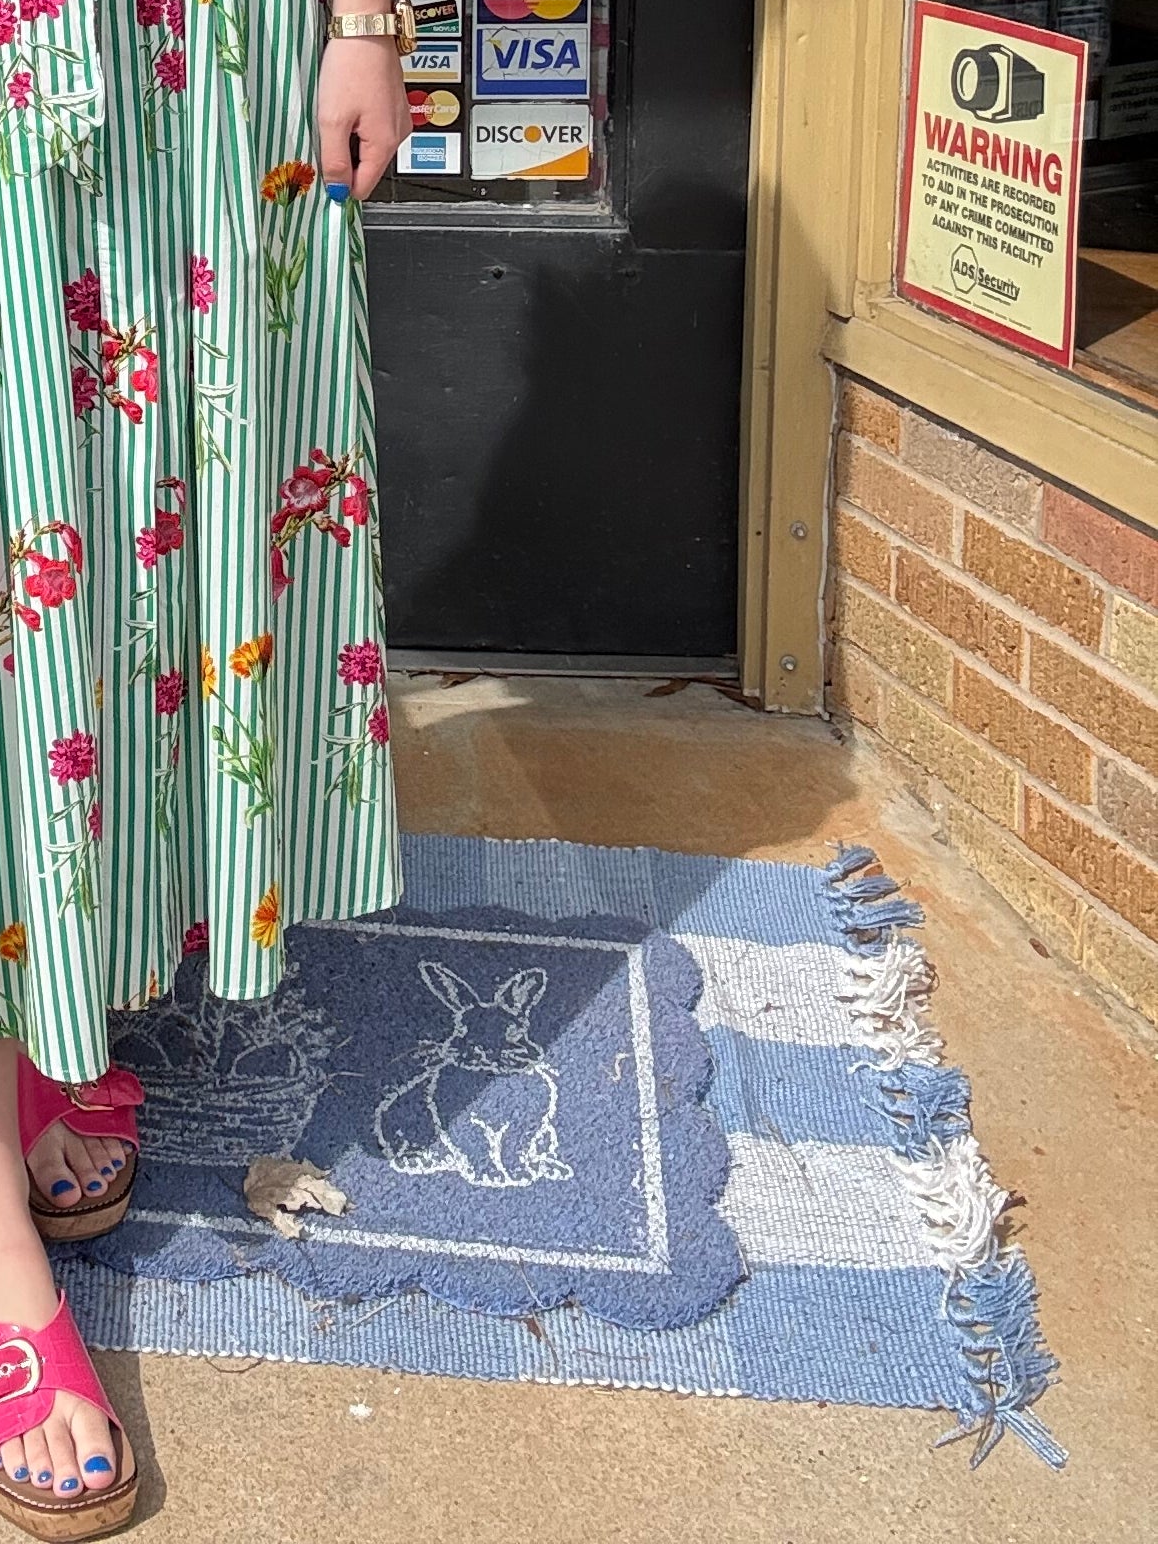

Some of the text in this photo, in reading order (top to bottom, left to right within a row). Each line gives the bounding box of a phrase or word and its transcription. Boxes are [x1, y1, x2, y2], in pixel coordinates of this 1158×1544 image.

[414, 4, 456, 20] SCOVER
[410, 55, 451, 69] VISA
[489, 39, 581, 70] VISA
[410, 104, 458, 114] asterCard
[476, 125, 584, 144] DISCOVER
[924, 111, 1063, 196] WARNING
[922, 174, 1059, 236] TO AID IN THE PROSECUTION
[927, 158, 1056, 215] ACTIVITIES ARE RECORDED
[924, 193, 1053, 253] OF ANY CRIME COMMITTED
[932, 214, 1043, 268] AGAINST THIS FACILITY
[953, 259, 1020, 298] ADS Security
